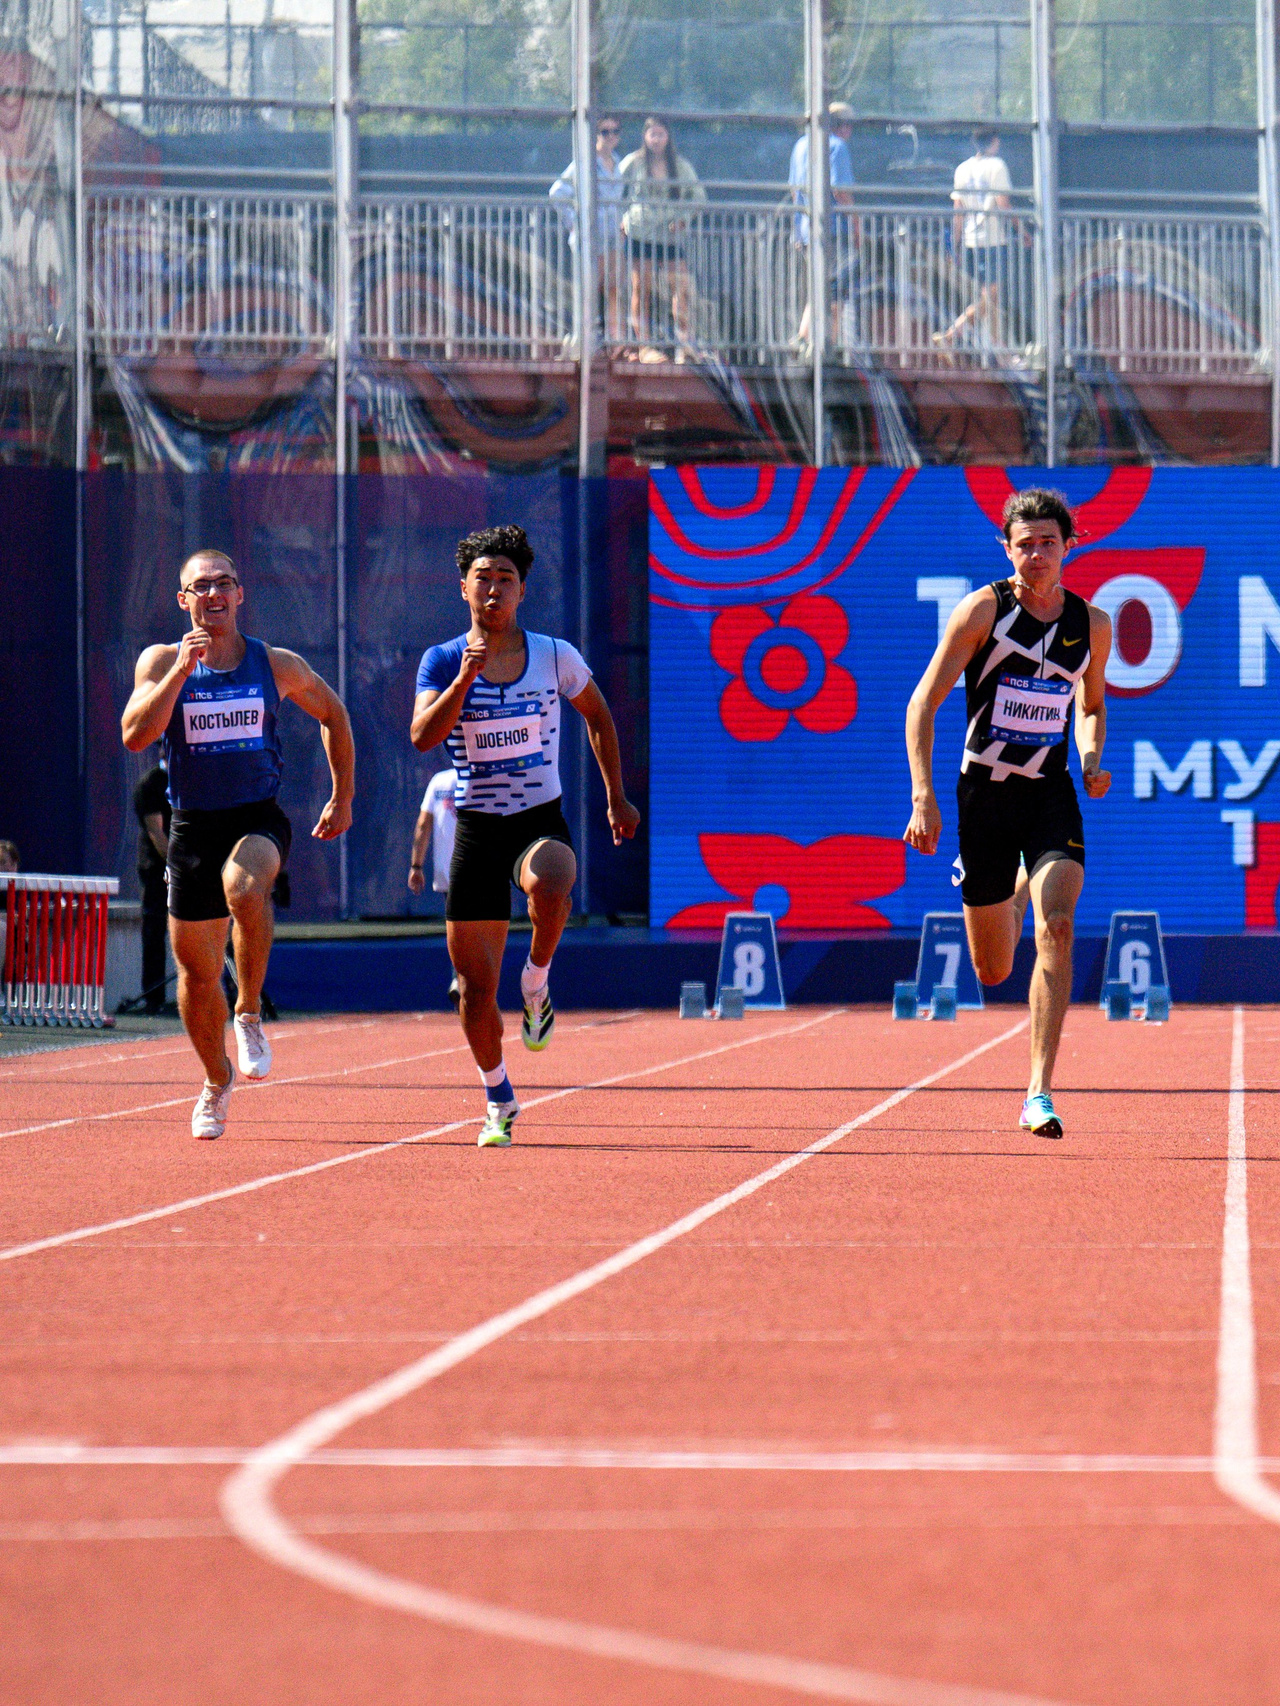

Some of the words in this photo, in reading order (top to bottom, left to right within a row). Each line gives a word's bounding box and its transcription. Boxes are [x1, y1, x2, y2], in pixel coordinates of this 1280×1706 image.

[916, 576, 1181, 688] 10
[1009, 678, 1029, 688] ПСБ
[195, 691, 213, 700] ПСБ
[189, 709, 259, 731] КОСТЫЛЕВ
[470, 710, 490, 719] ПСБ
[1003, 699, 1061, 722] НИКИТИН
[475, 727, 529, 749] ШОЕНОВ
[1221, 811, 1255, 867] 1
[733, 942, 765, 997] 8
[934, 943, 961, 988] 7
[1119, 940, 1151, 994] 6
